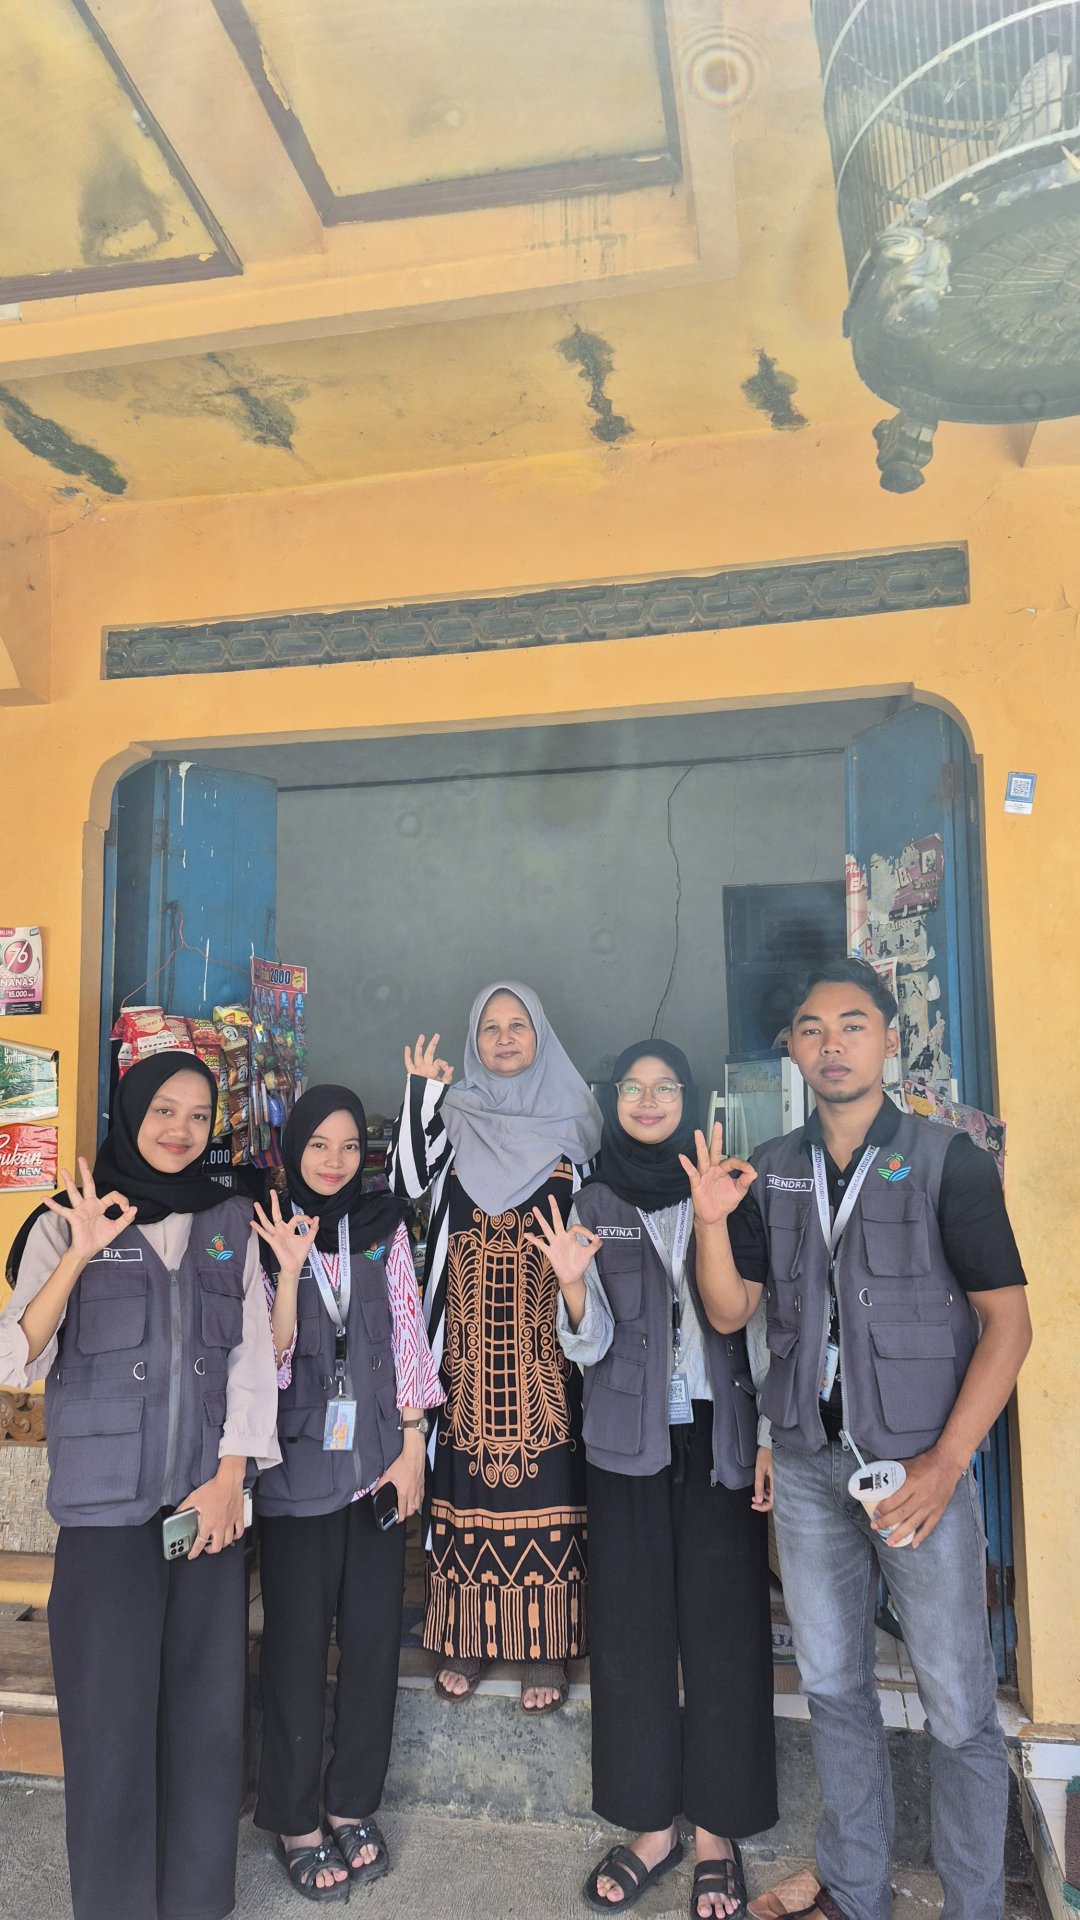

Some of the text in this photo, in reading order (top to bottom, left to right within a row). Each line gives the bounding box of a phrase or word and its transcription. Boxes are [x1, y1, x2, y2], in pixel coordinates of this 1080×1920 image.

[7, 941, 28, 970] 76
[270, 967, 291, 985] 2000
[202, 1149, 230, 1165] .000
[18, 1167, 41, 1176] NEW
[768, 1177, 807, 1189] HENDRA
[597, 1228, 633, 1238] DEVINA
[103, 1249, 122, 1259] BIA
[309, 1246, 322, 1276] ONOSOBO
